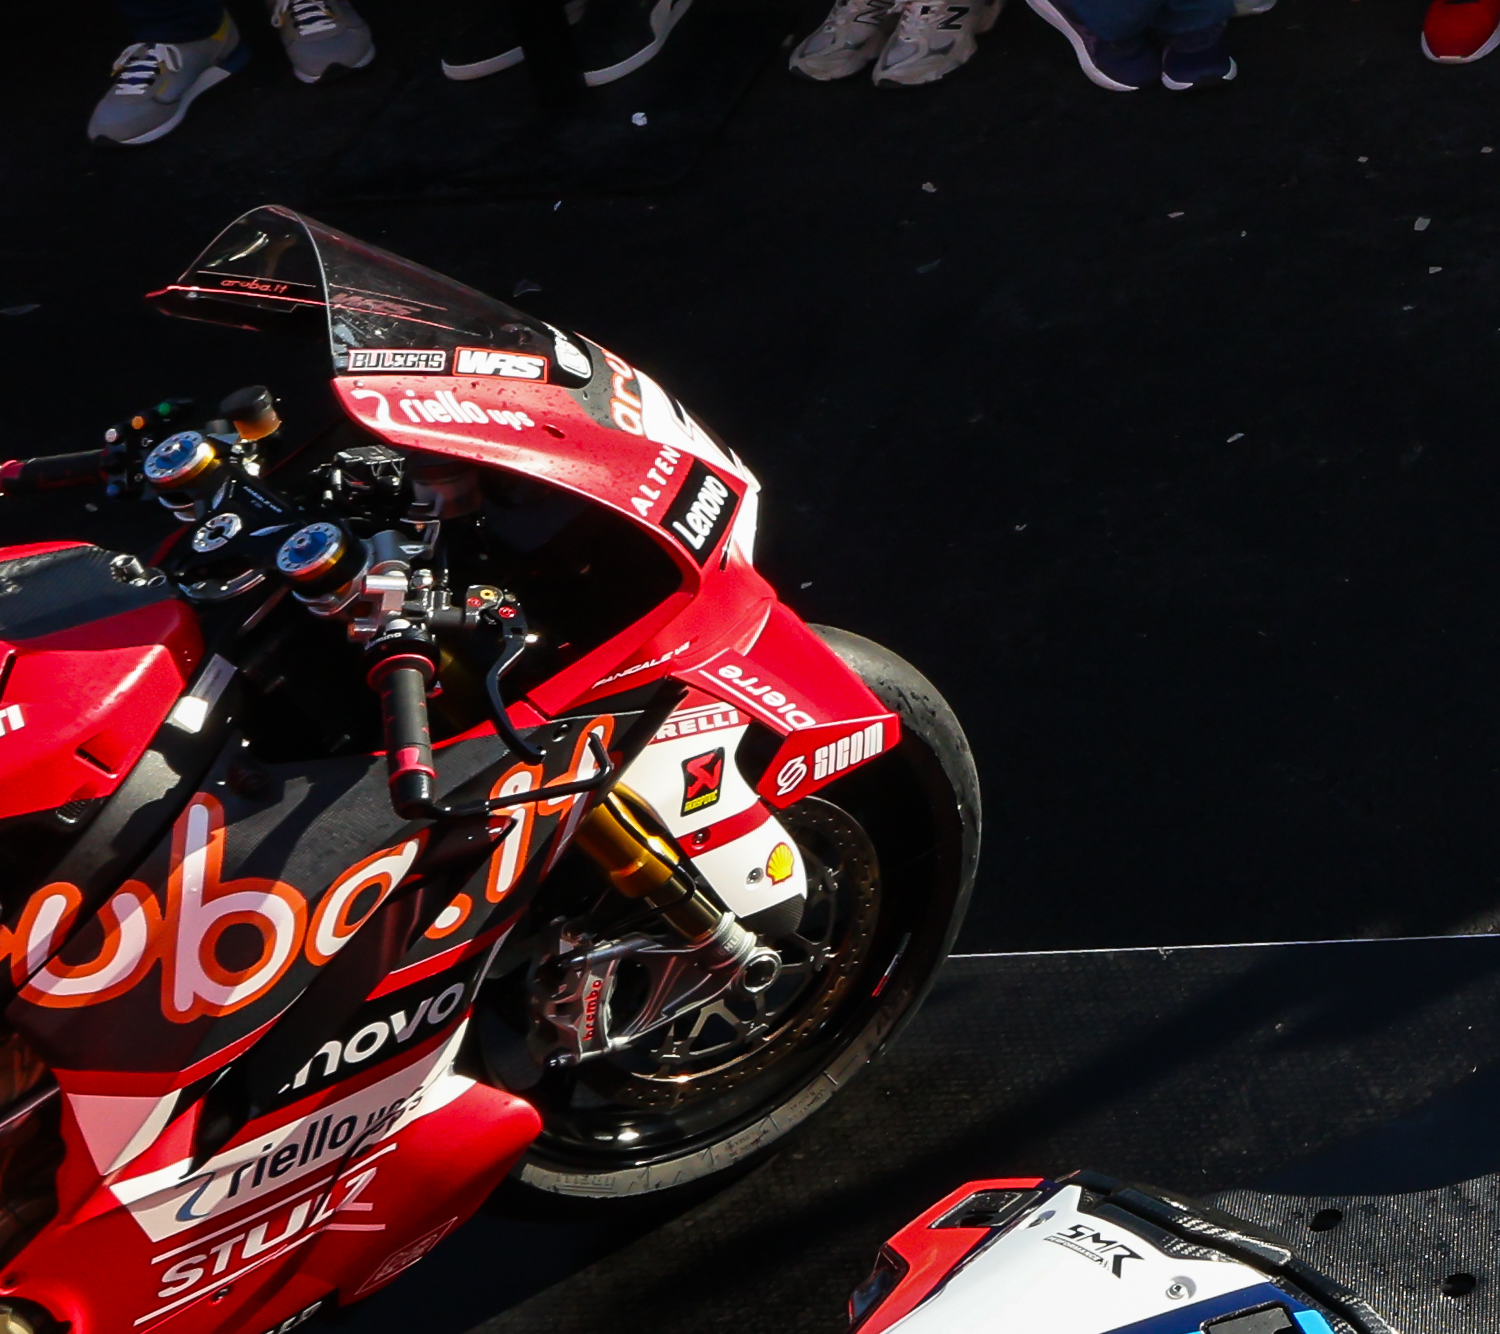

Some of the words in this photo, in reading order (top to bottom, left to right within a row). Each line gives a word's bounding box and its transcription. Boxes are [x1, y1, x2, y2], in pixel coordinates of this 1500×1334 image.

[456, 349, 542, 379] WRS
[400, 385, 485, 426] riello
[489, 405, 536, 430] ups
[630, 443, 682, 517] ALTEN
[672, 474, 732, 550] Lenovo
[655, 700, 741, 742] RELLI
[813, 722, 884, 784] SICOM
[227, 1111, 357, 1200] riello
[158, 1165, 379, 1300] STULZ
